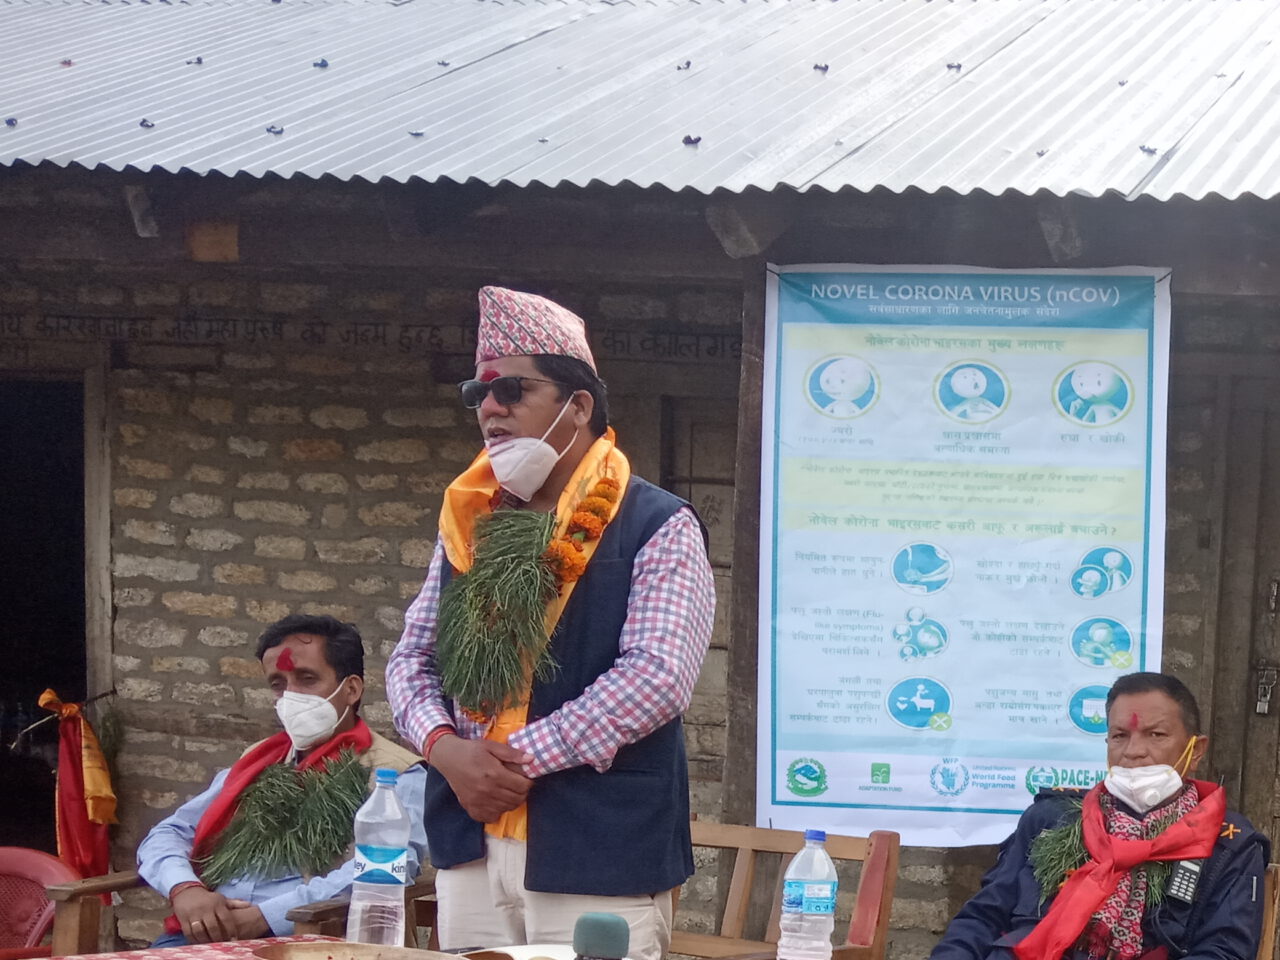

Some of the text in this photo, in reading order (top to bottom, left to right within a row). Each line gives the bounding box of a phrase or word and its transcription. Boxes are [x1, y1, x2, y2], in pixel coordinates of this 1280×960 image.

[810, 283, 1120, 307] NOVEL CORONA VIRUS (nCOV)
[971, 773, 1016, 782] World Food
[971, 781, 1016, 791] Programme
